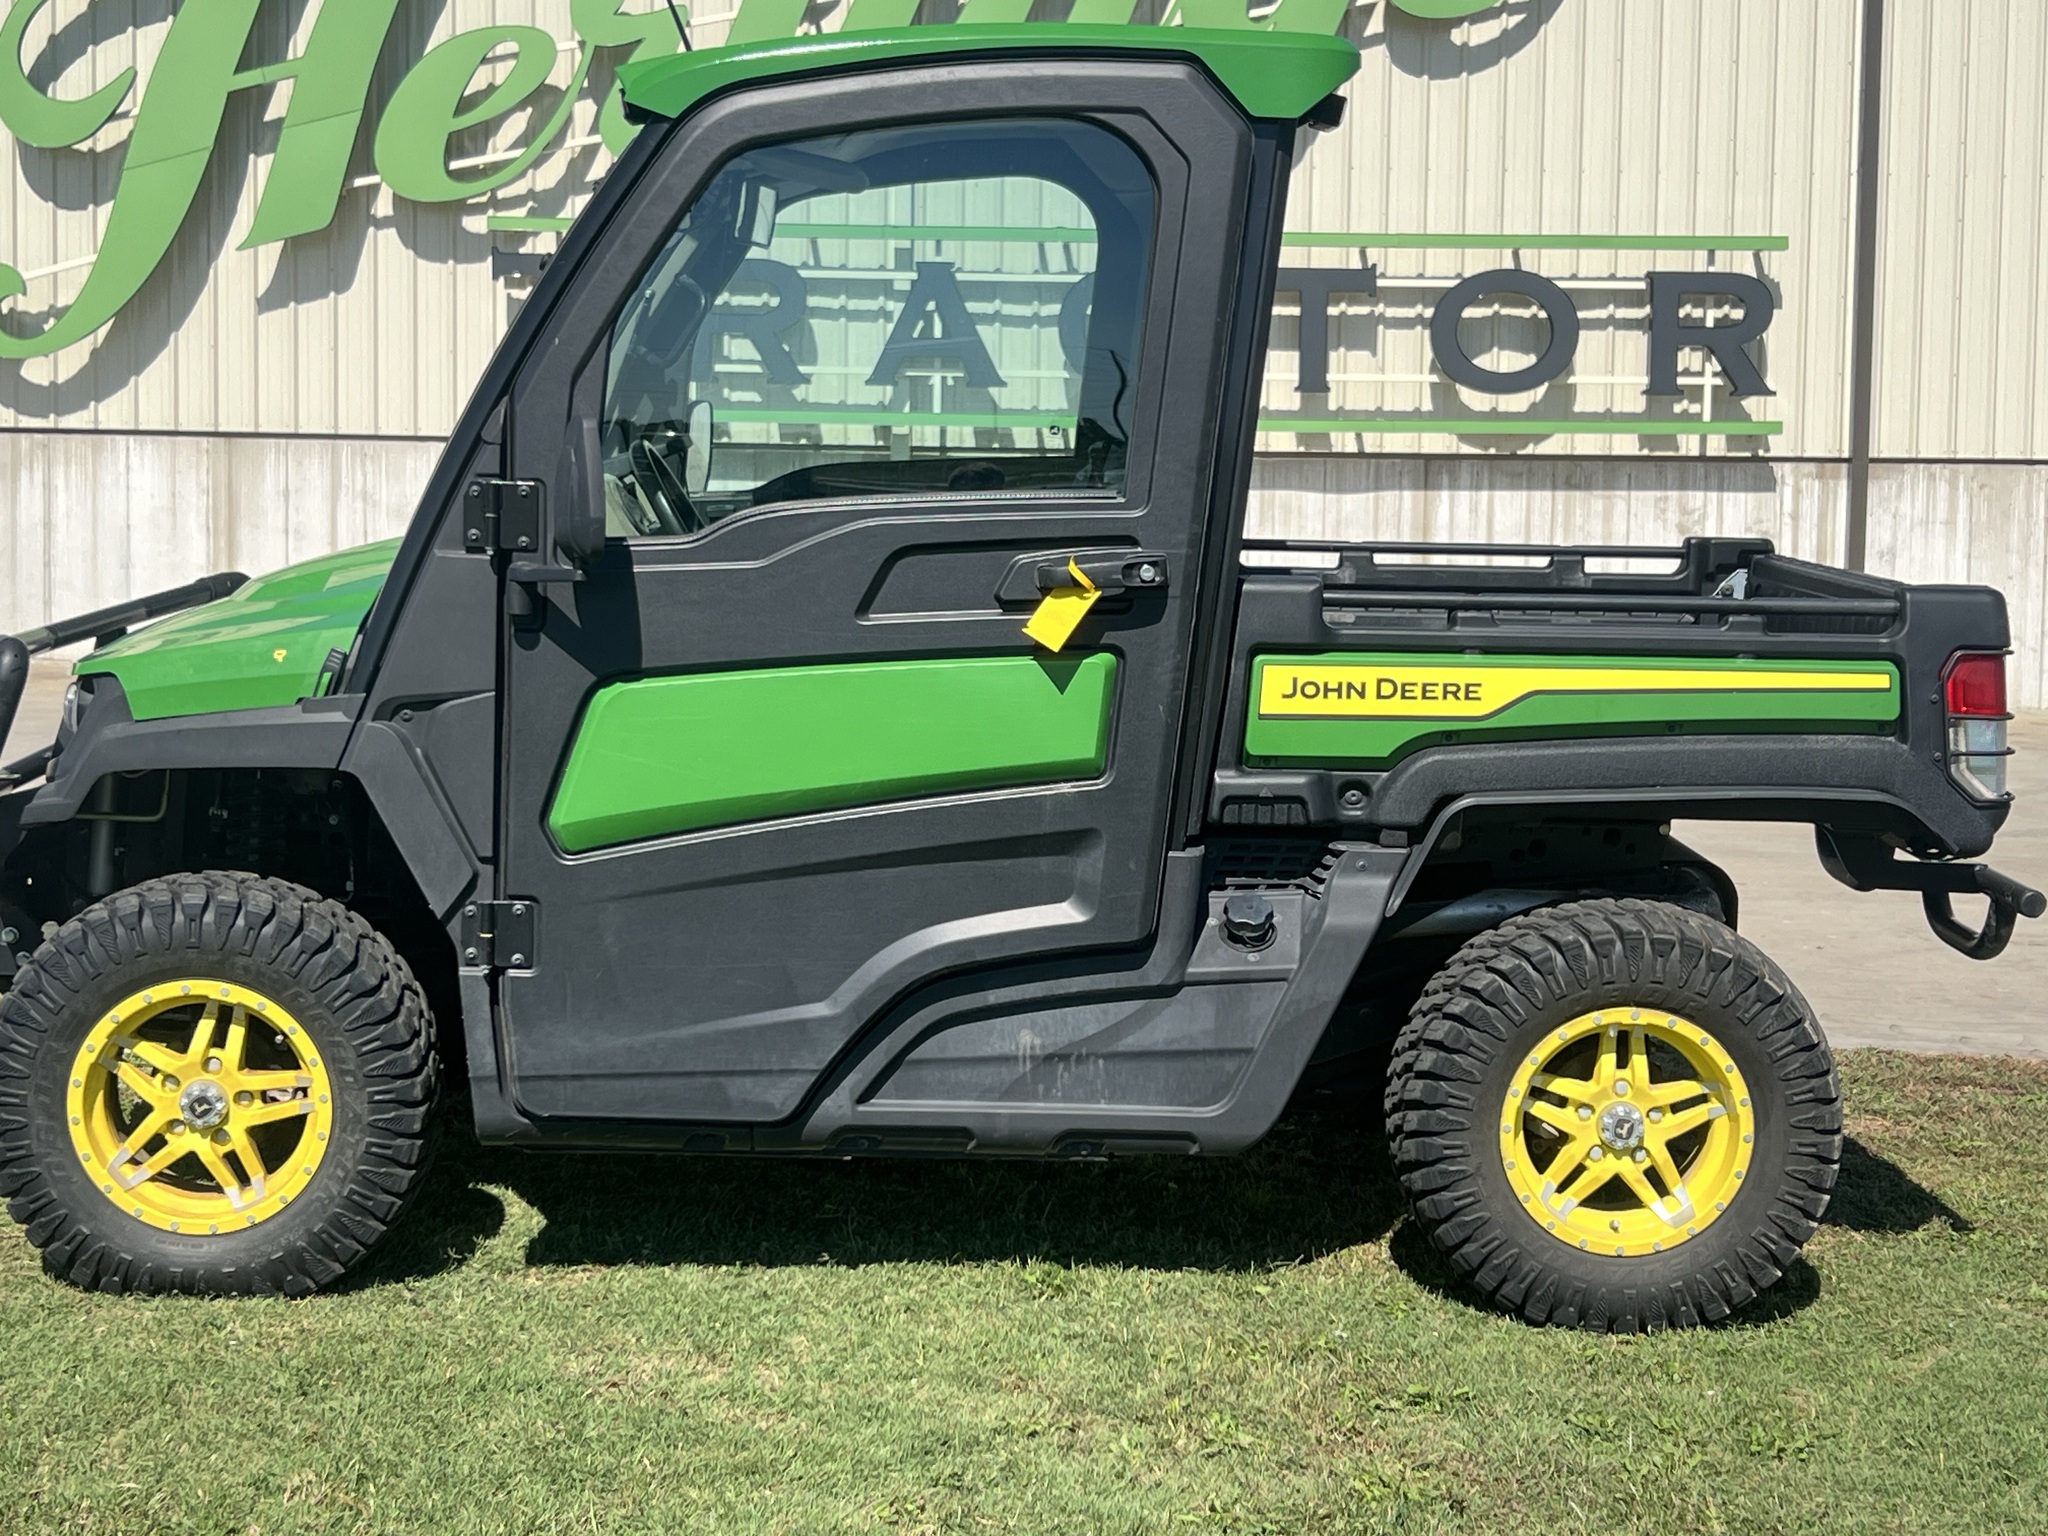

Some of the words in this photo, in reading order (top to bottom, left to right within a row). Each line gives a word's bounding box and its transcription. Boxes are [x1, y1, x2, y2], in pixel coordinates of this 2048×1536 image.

[492, 246, 1776, 397] RATOR
[1281, 676, 1367, 700] JOHN
[1376, 677, 1483, 701] DEERE
